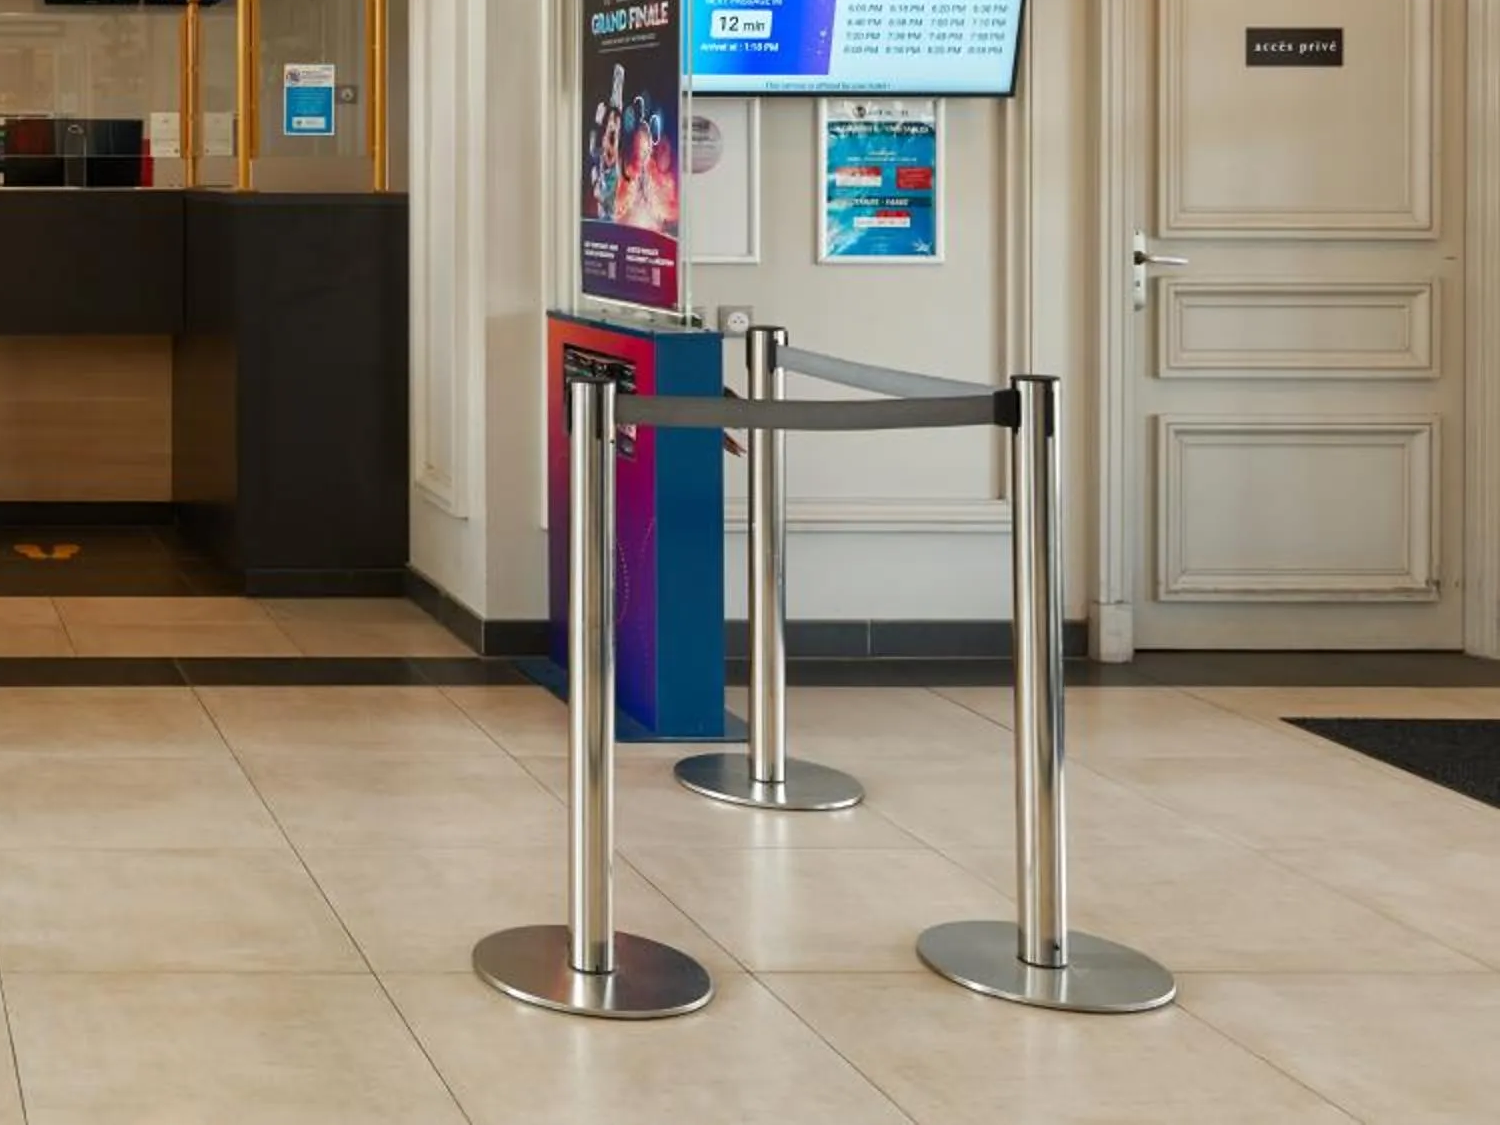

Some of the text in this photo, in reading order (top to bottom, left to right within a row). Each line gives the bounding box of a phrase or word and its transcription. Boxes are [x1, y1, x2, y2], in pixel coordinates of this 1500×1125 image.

[591, 8, 627, 36] GRAND
[629, 0, 669, 30] FINALE
[719, 16, 765, 32] 12 min
